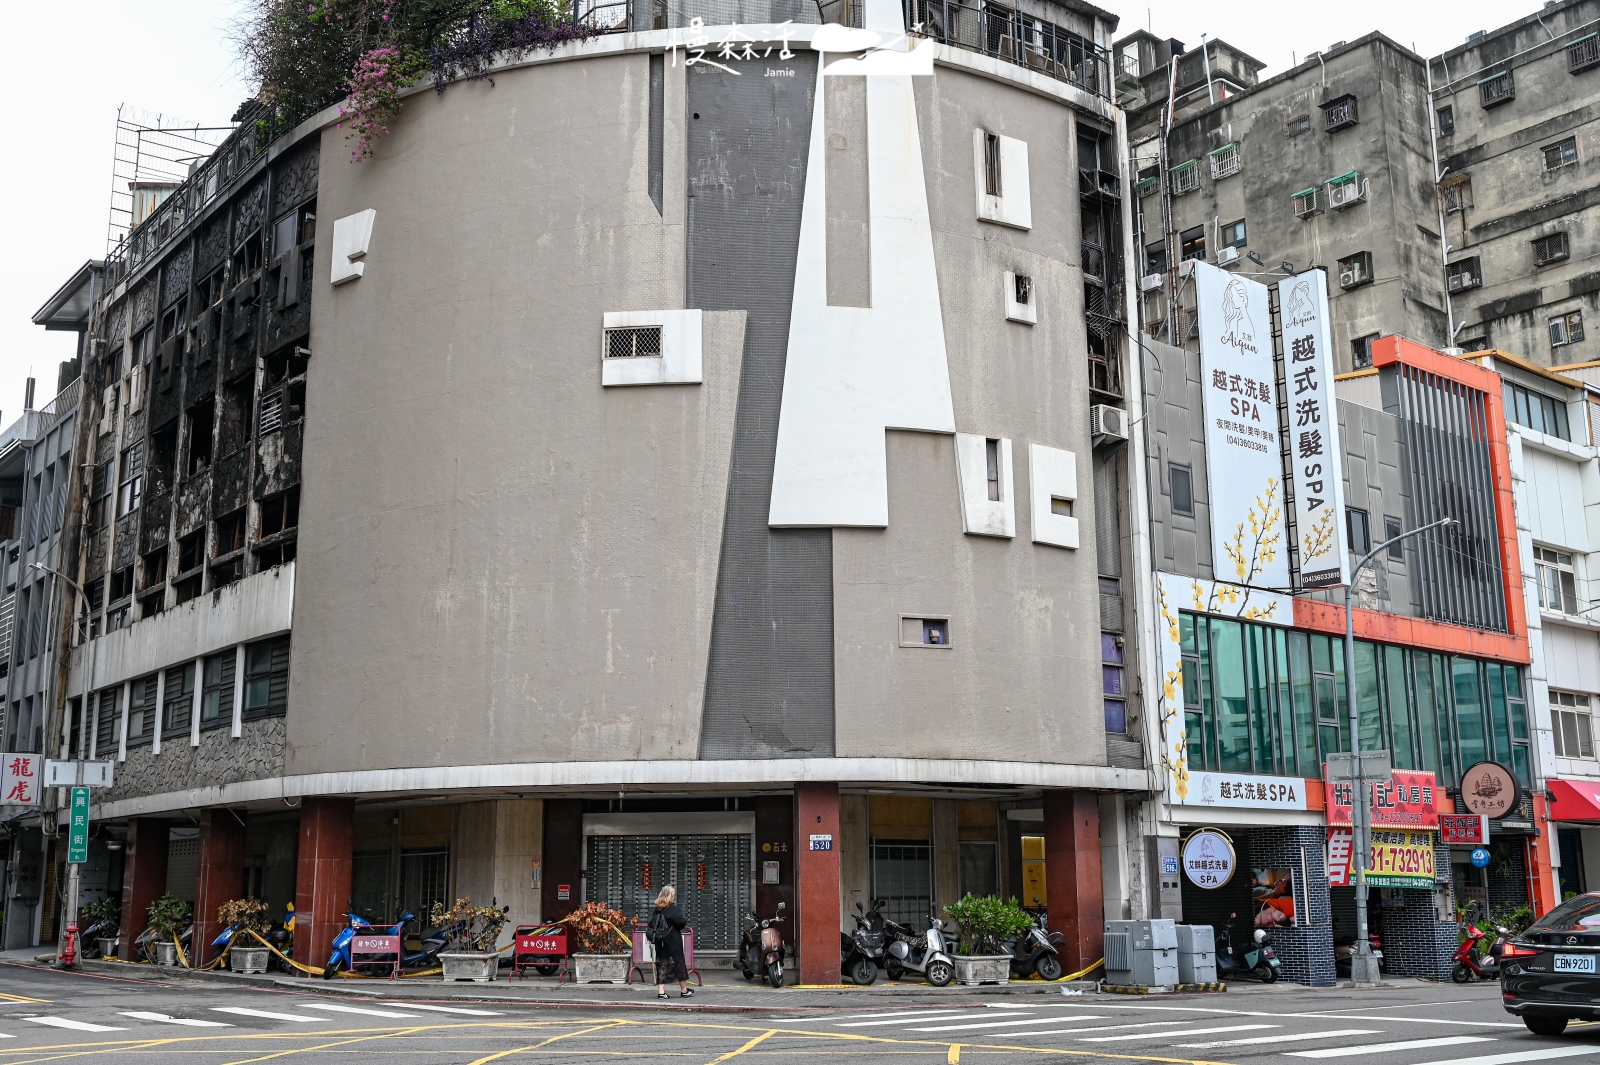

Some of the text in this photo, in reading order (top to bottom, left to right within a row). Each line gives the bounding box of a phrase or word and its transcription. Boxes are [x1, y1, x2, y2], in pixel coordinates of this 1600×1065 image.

[1221, 331, 1259, 355] Aiqun
[1212, 368, 1272, 405] 越式洗髮
[1230, 397, 1261, 422] SPA
[6, 757, 34, 802] 龍虎
[1397, 785, 1432, 804] 私房菜
[73, 796, 85, 845] 興民街
[814, 840, 830, 850] 520
[1328, 829, 1353, 885] 售
[1200, 875, 1218, 884] SPA
[1555, 958, 1593, 970] CBN-9201
